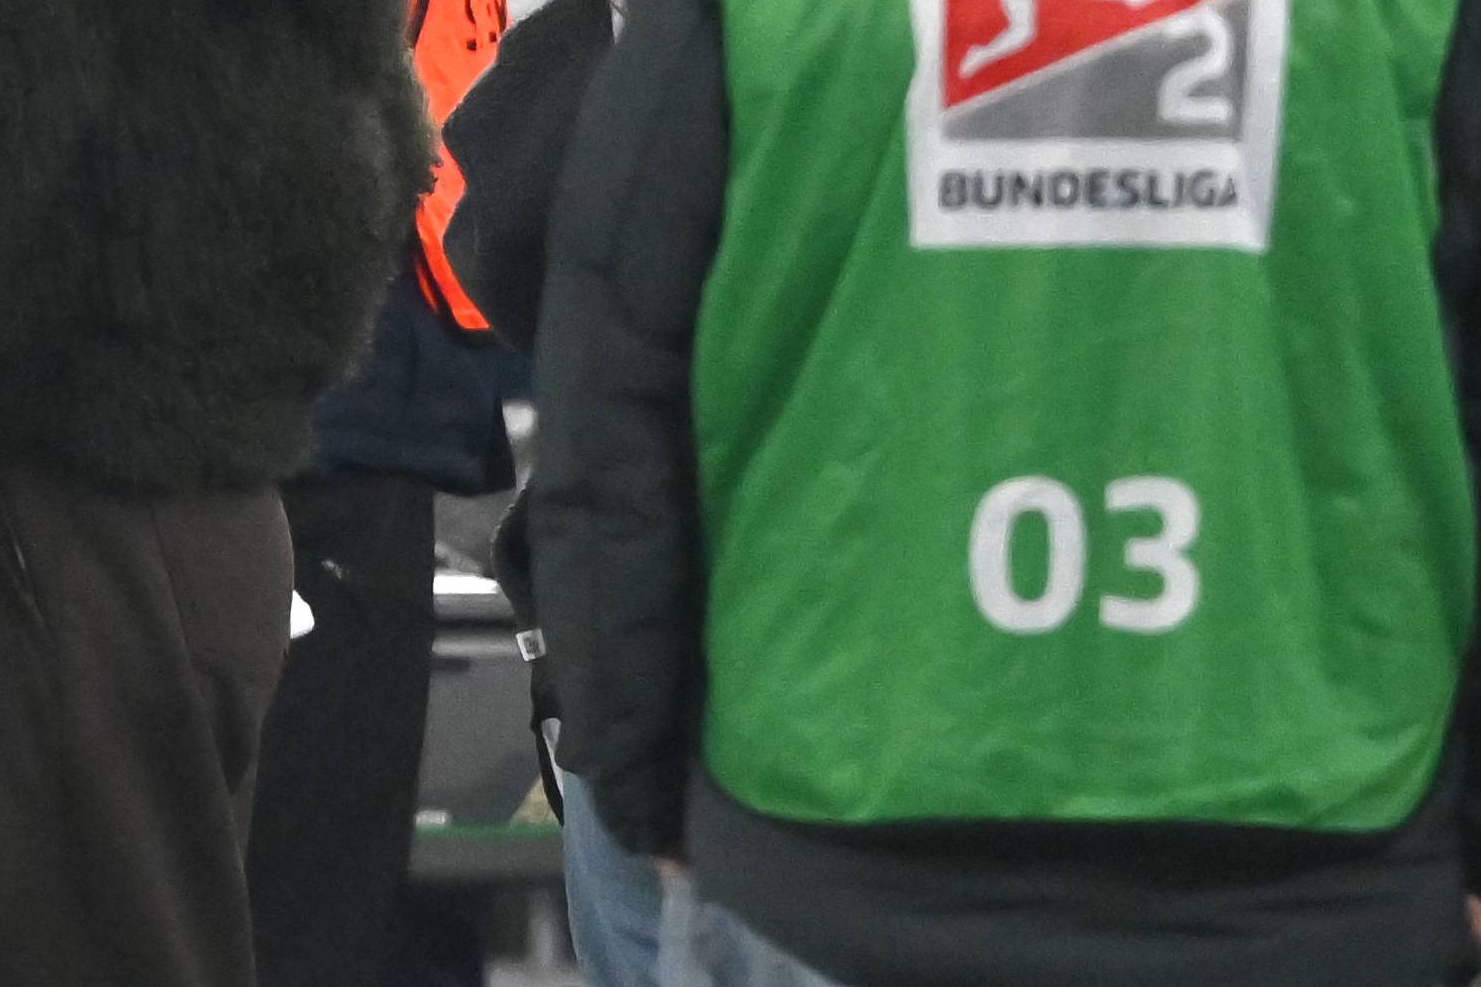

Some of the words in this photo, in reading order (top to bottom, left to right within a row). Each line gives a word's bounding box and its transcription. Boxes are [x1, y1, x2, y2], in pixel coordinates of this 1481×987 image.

[1158, 6, 1233, 125] 2
[937, 166, 1238, 211] BUNDESLIGA
[970, 474, 1201, 635] 03
